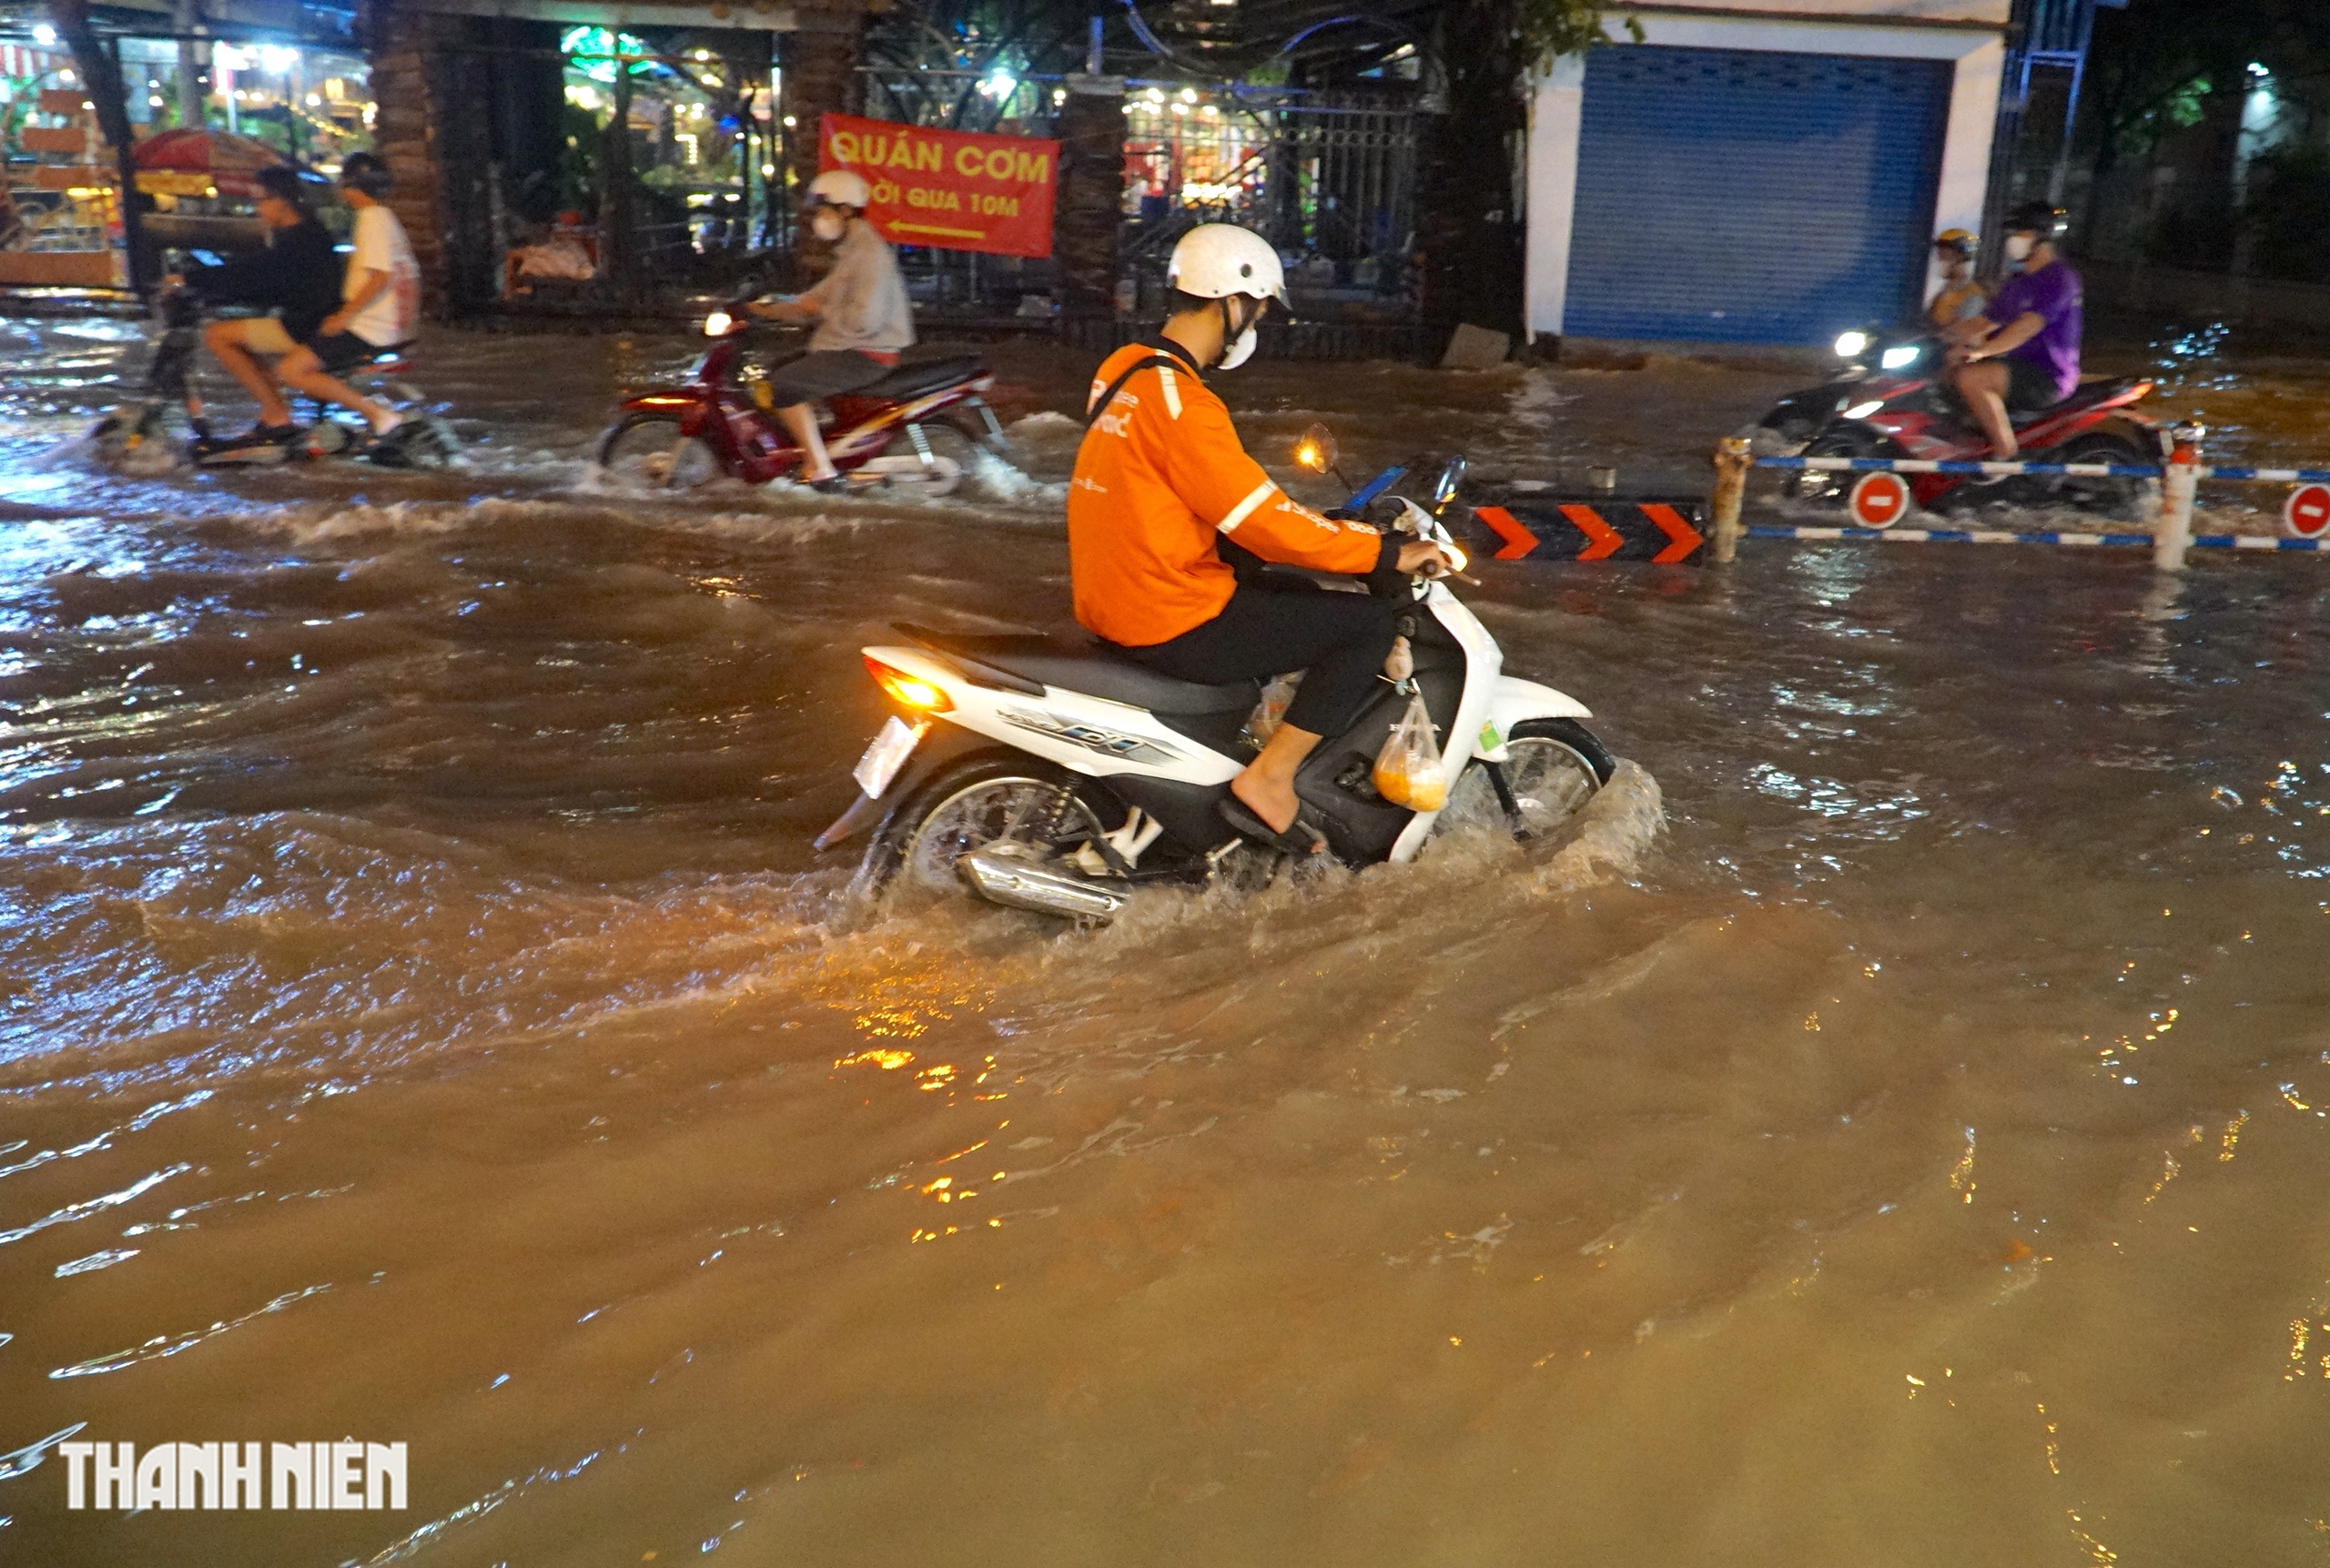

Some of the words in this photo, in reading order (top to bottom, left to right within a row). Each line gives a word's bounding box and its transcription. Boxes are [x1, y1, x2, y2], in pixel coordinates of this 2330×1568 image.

[829, 130, 944, 172] QUÁN
[954, 146, 1049, 184] CƠM
[869, 177, 900, 204] ỜI
[907, 187, 960, 211] QUA
[968, 193, 1018, 217] 10M
